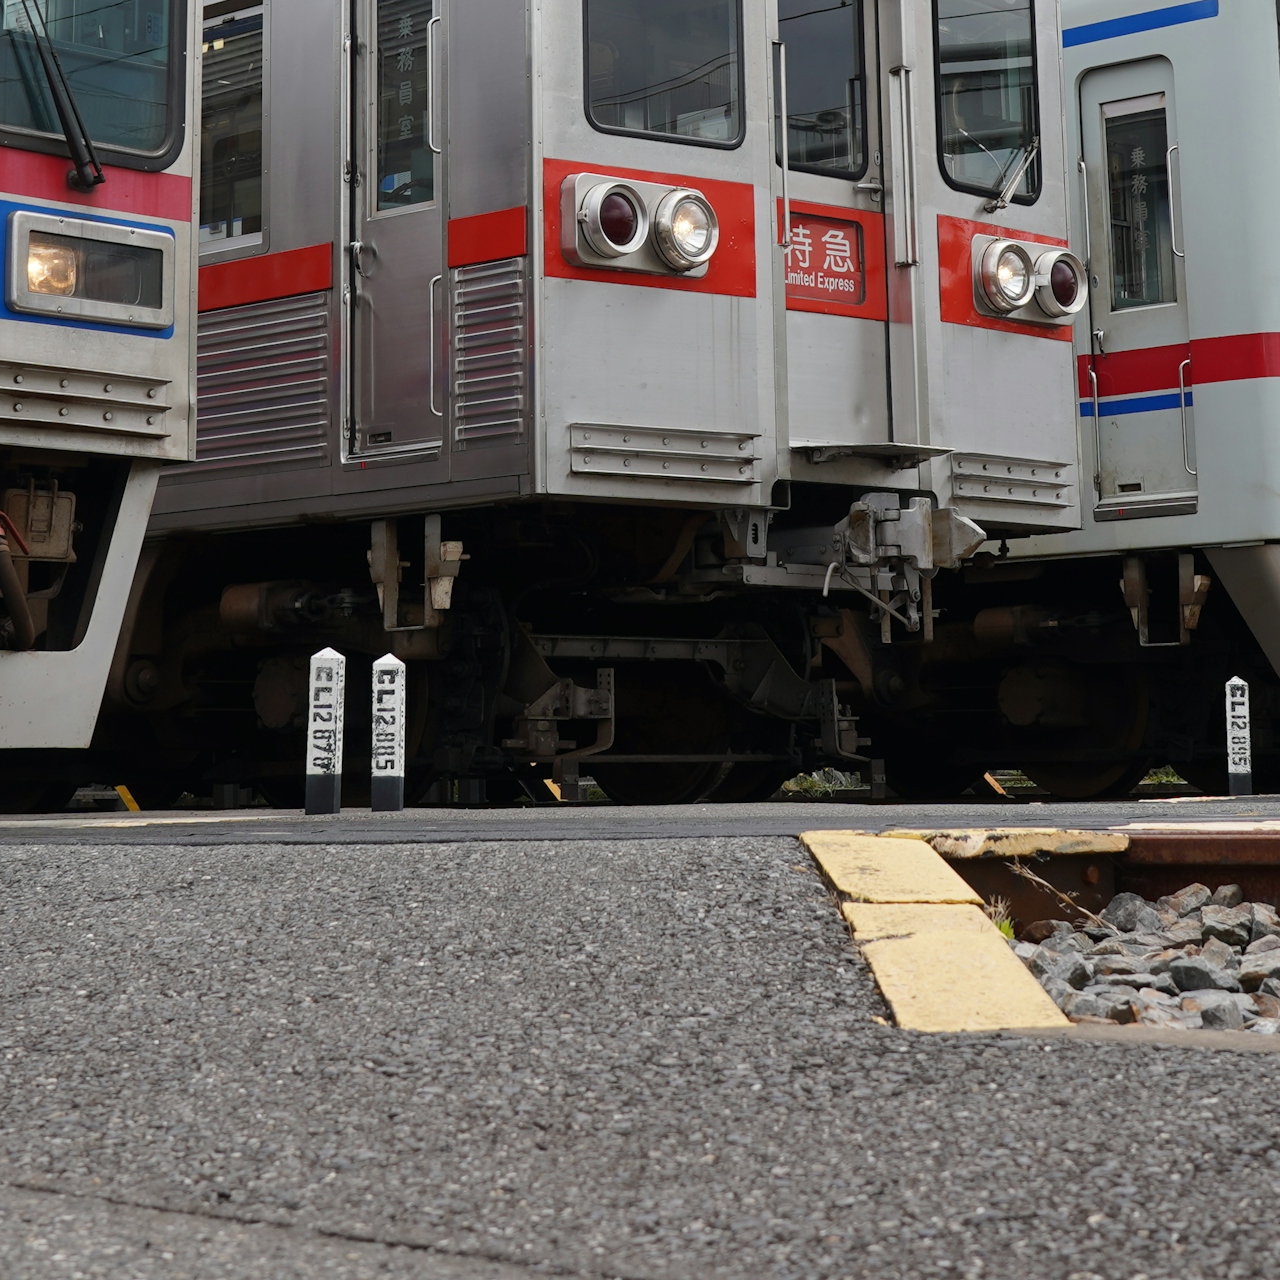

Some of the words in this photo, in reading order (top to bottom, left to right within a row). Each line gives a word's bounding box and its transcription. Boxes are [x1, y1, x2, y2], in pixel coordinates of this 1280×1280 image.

[397, 14, 415, 140] 乗務員室
[1131, 146, 1150, 250] 乗務員室
[784, 224, 855, 273] 特急
[817, 272, 855, 292] Express
